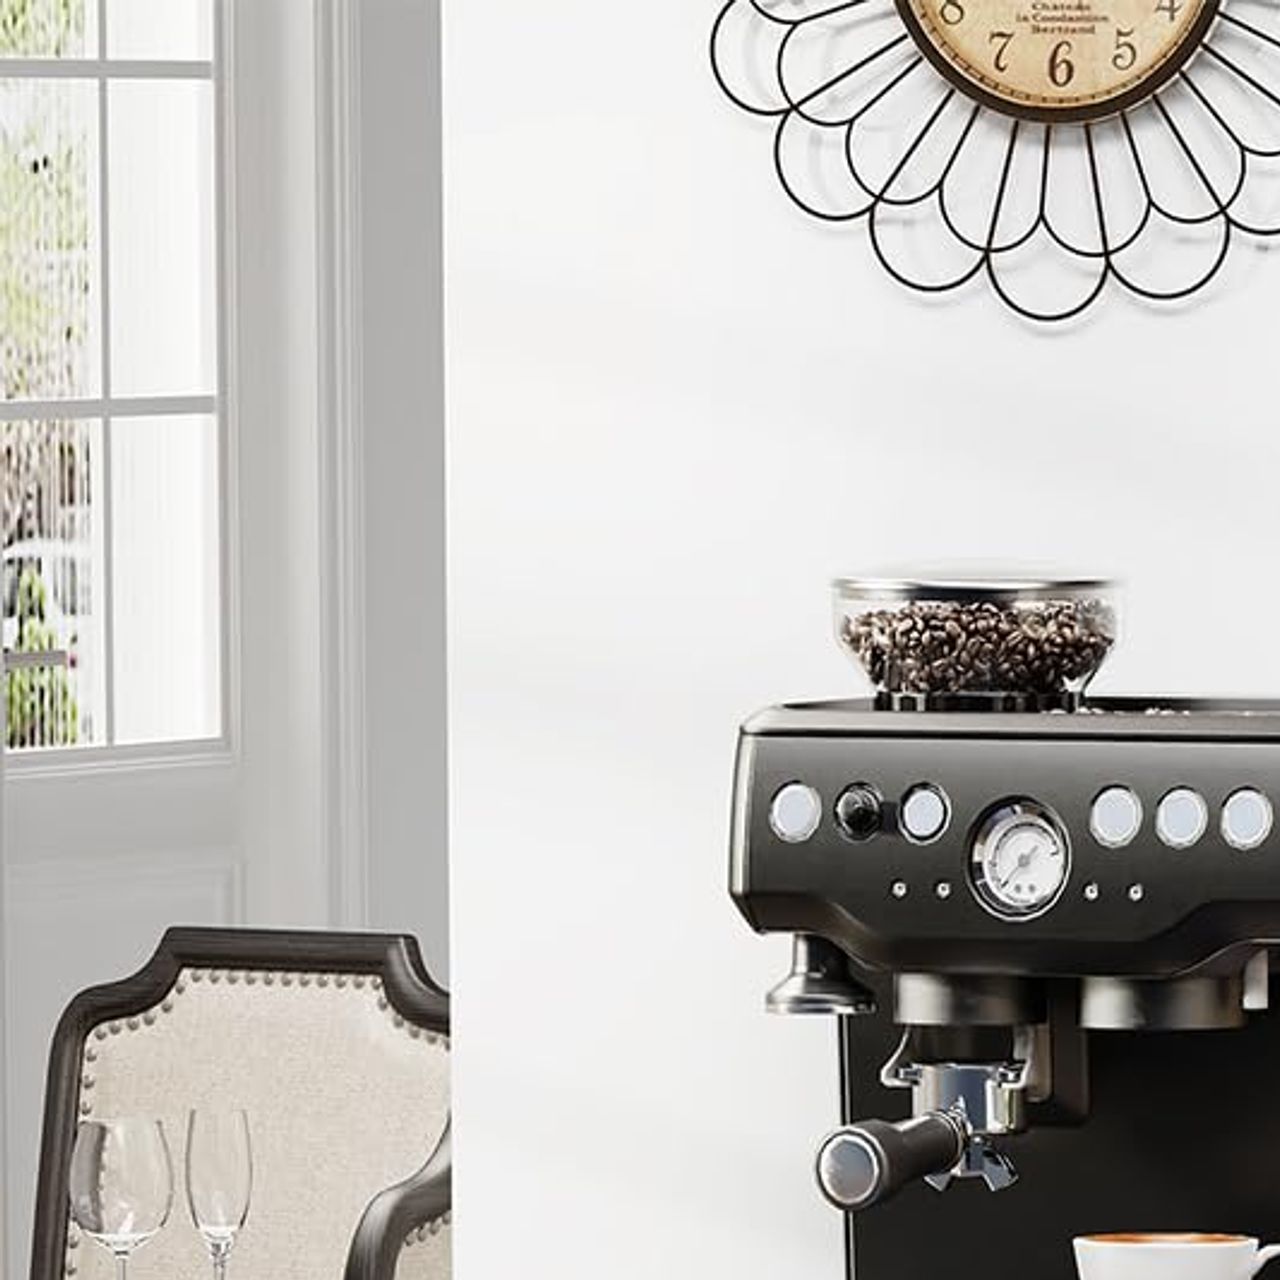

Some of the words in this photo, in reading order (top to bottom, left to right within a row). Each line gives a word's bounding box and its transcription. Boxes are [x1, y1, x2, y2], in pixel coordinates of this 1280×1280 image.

[939, 0, 965, 25] 8
[988, 31, 1015, 73] 7
[1048, 40, 1075, 87] 6
[1111, 27, 1138, 71] 5
